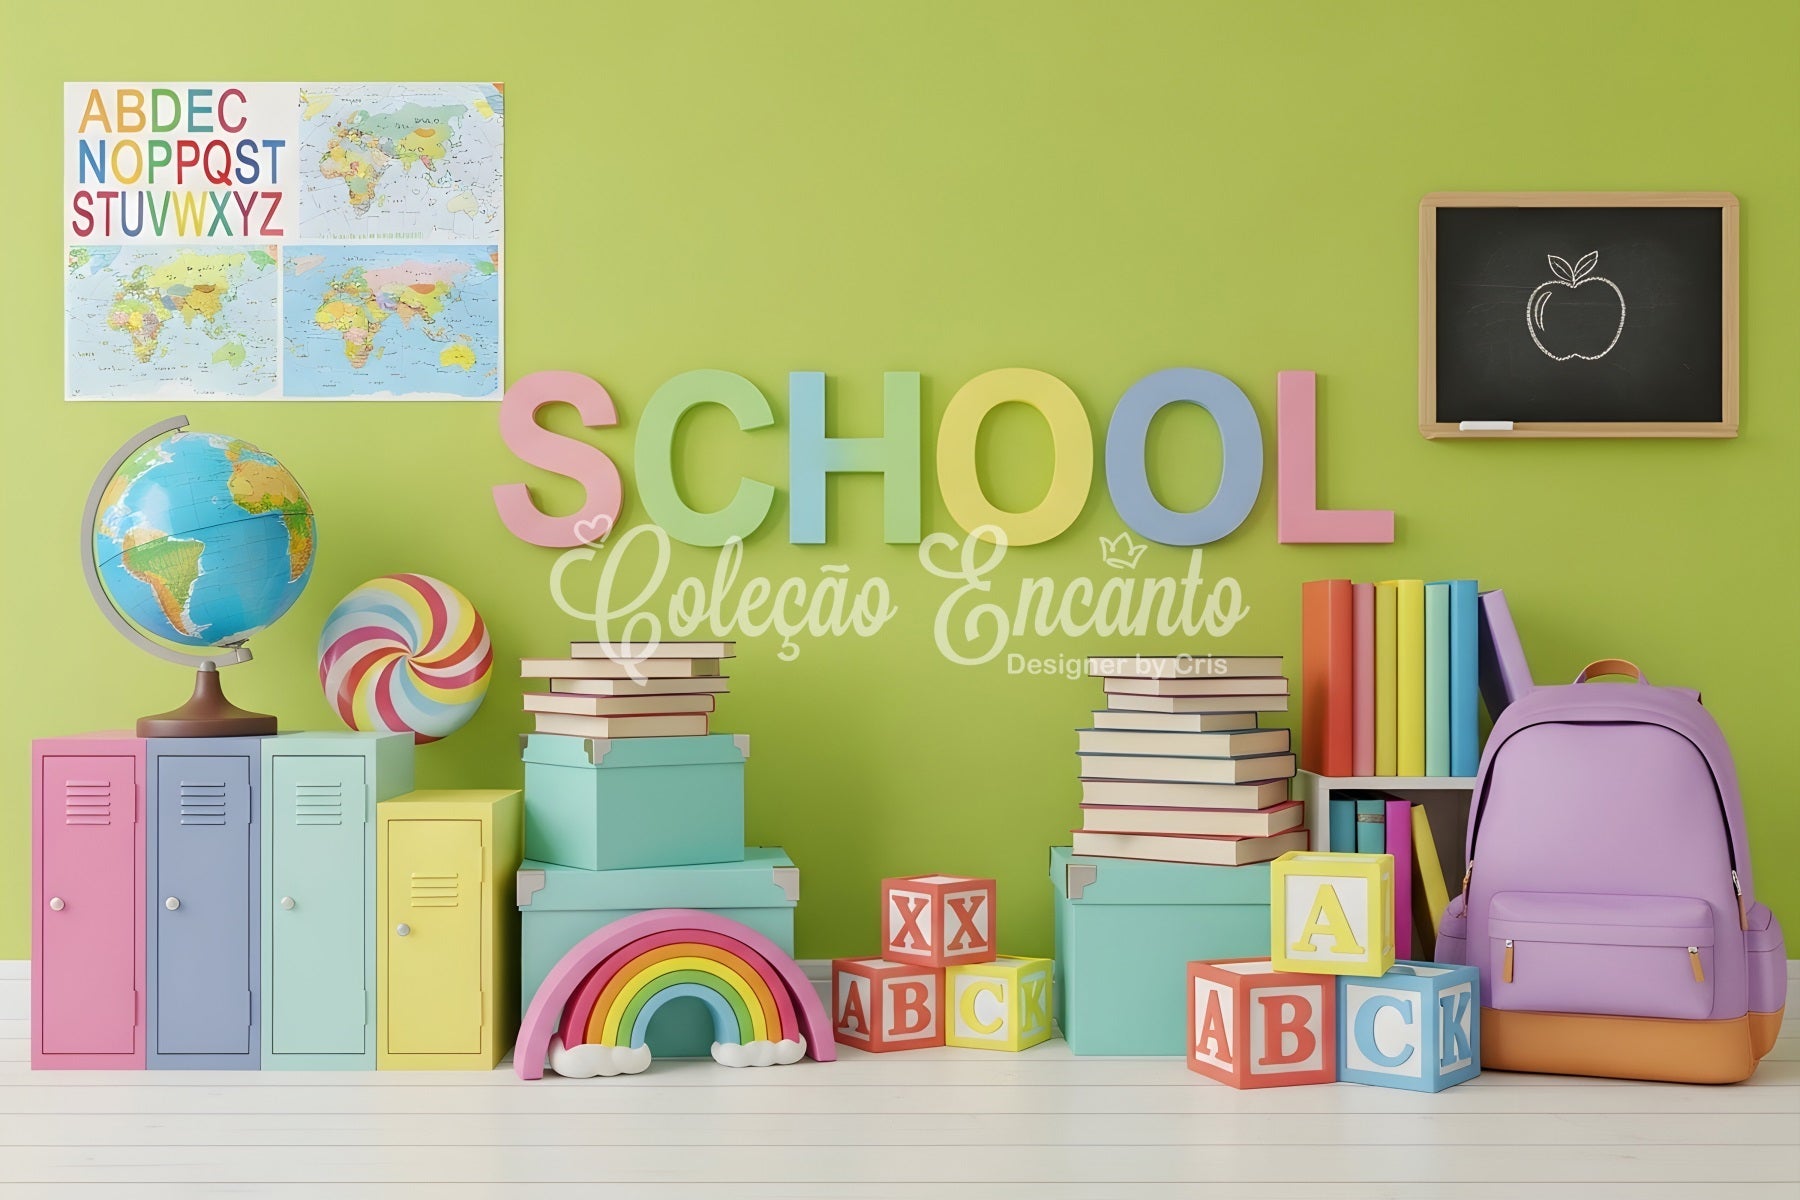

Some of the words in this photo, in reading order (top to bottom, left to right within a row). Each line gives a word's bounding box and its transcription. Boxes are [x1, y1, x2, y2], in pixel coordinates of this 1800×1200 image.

[78, 88, 247, 133] ABDEC
[79, 138, 285, 186] NOPPQST
[72, 190, 284, 237] STUVWXYZ
[492, 368, 1395, 547] SCHOOL
[891, 894, 932, 949] X
[947, 895, 988, 951] X
[1291, 884, 1365, 955] A
[838, 981, 870, 1035] A
[888, 981, 932, 1036] B
[960, 981, 1004, 1034] C
[1195, 989, 1233, 1063] A
[1258, 994, 1316, 1066] B
[1354, 995, 1415, 1067] C
[1440, 991, 1472, 1068] K
